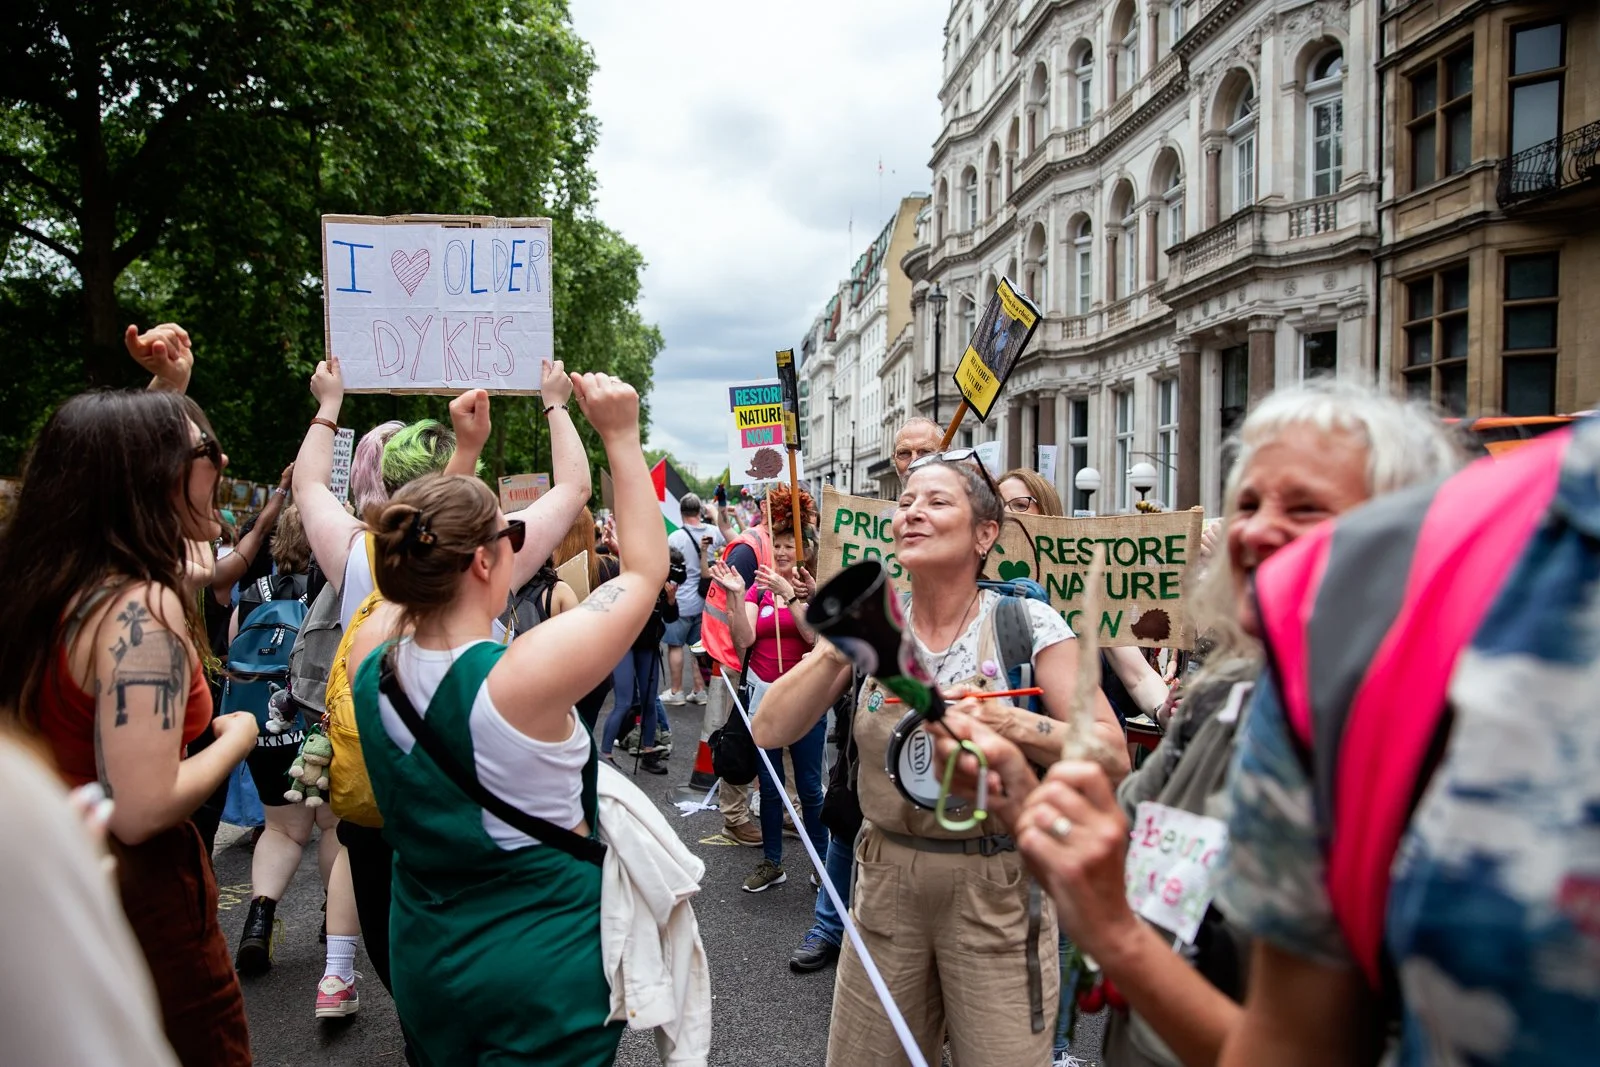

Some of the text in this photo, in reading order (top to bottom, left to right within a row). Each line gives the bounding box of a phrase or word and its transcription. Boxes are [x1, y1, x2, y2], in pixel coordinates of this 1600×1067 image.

[332, 239, 546, 296] I OLDER
[372, 314, 515, 382] DYKES
[970, 356, 992, 384] RESTORE
[745, 428, 774, 446] NOW
[1035, 535, 1186, 566] RESTORE
